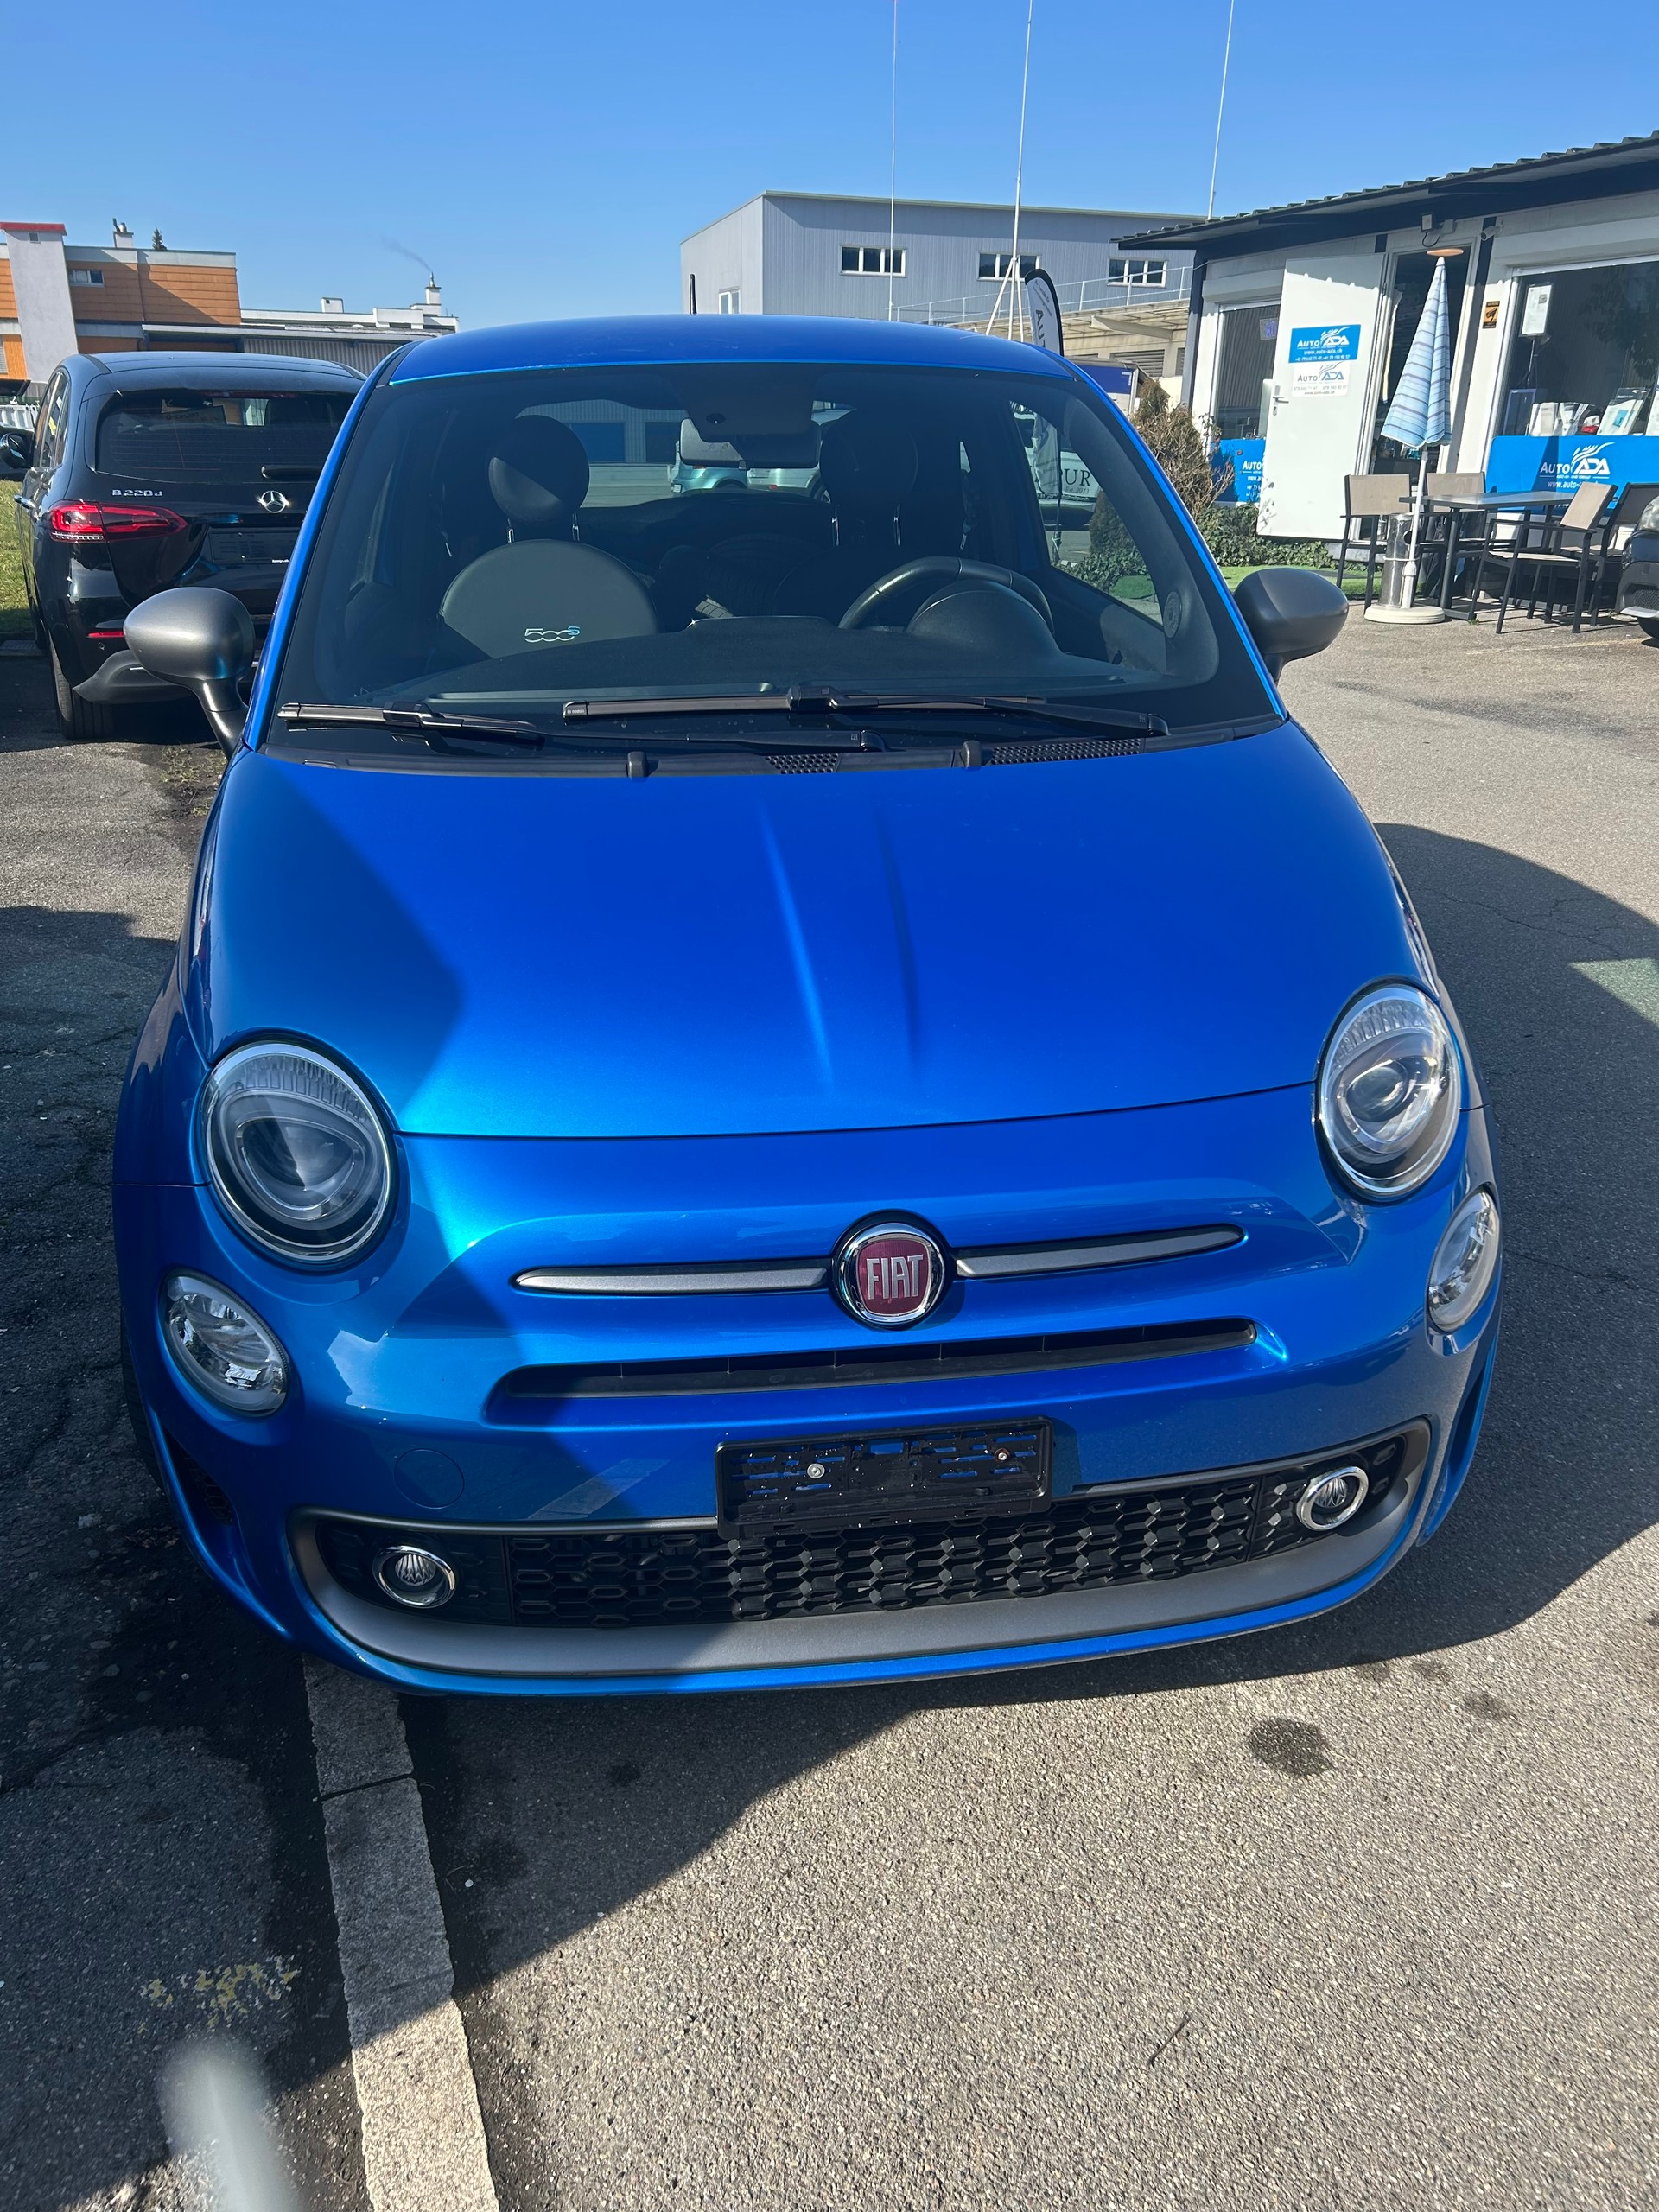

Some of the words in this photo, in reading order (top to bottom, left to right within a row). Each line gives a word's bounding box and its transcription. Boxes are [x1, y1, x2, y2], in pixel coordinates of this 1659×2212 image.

[1322, 335, 1350, 346] ADA
[1321, 371, 1344, 381] ADA
[1243, 460, 1262, 471] AUTO
[1540, 462, 1571, 474] AUTO
[1573, 458, 1611, 475] ADA
[866, 1254, 924, 1300] FIAT
